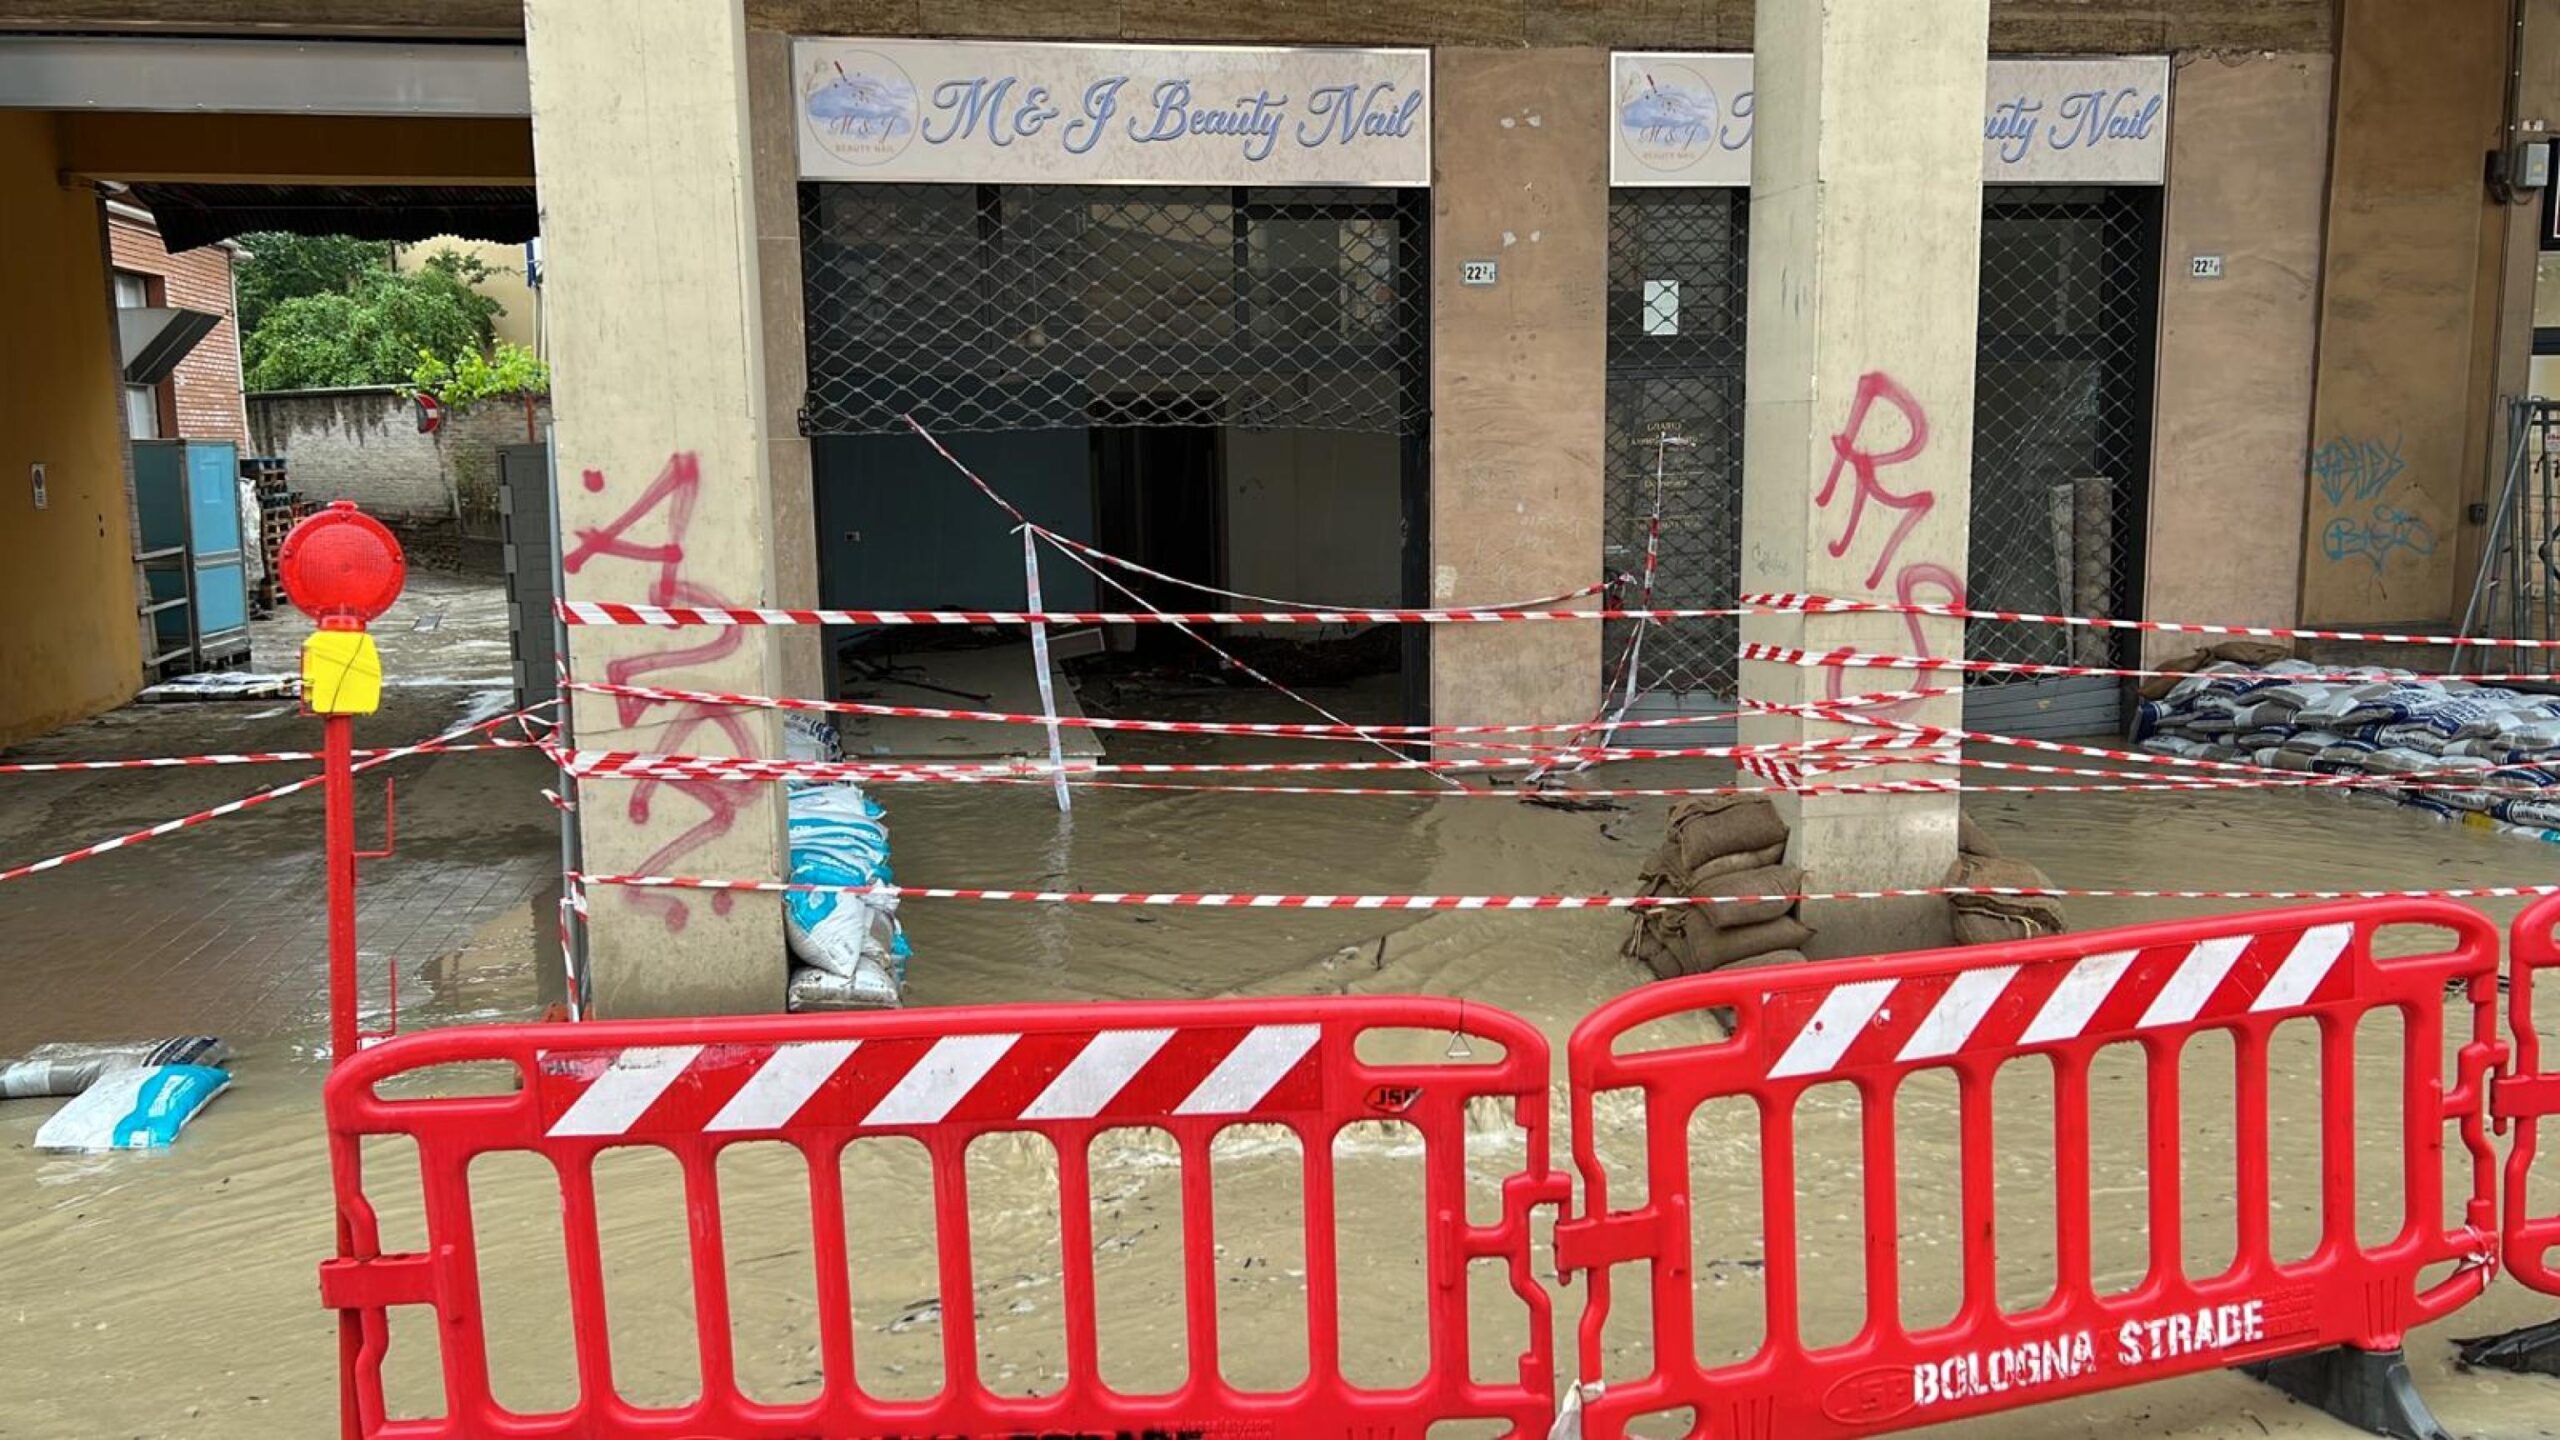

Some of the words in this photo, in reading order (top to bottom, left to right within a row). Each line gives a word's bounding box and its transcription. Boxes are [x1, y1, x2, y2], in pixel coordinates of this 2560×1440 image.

[922, 76, 1017, 146] M
[1013, 87, 1060, 136] &
[1063, 76, 1130, 154] J
[1127, 79, 1289, 161] Beauty
[1297, 81, 1423, 147] Nail
[2048, 87, 2164, 150] Nail
[1913, 1330, 2096, 1406] BOLOGNA
[2118, 1300, 2264, 1365] STRADE
